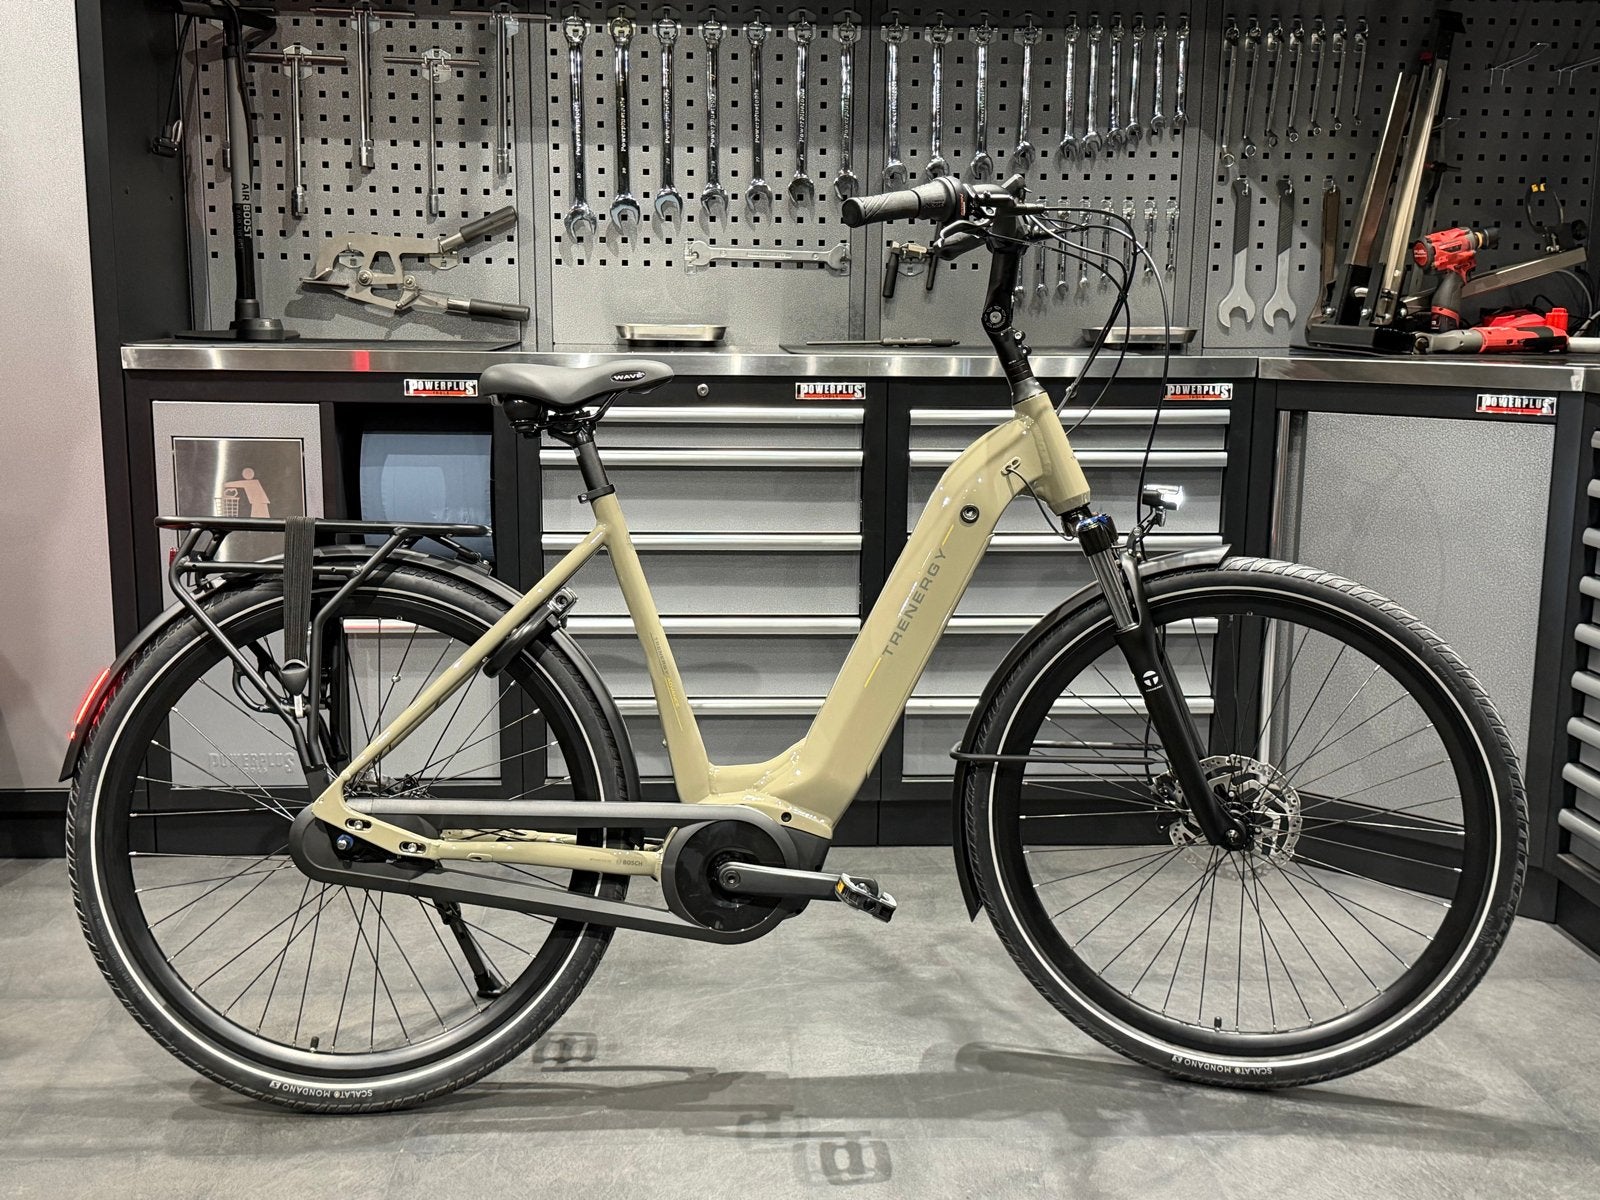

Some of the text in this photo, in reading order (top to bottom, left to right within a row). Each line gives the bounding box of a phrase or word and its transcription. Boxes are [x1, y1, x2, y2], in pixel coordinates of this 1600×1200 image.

[241, 182, 250, 201] AIR
[242, 204, 252, 239] BOOST
[408, 380, 475, 395] POWERPLUS
[800, 384, 863, 398] POWERPLUS
[1167, 384, 1230, 399] POWERPLUS
[1481, 396, 1553, 415] POWERPLUS
[882, 548, 946, 655] TRENERGY
[1183, 1058, 1232, 1074] MONDANO
[282, 1083, 331, 1098] MONDANO
